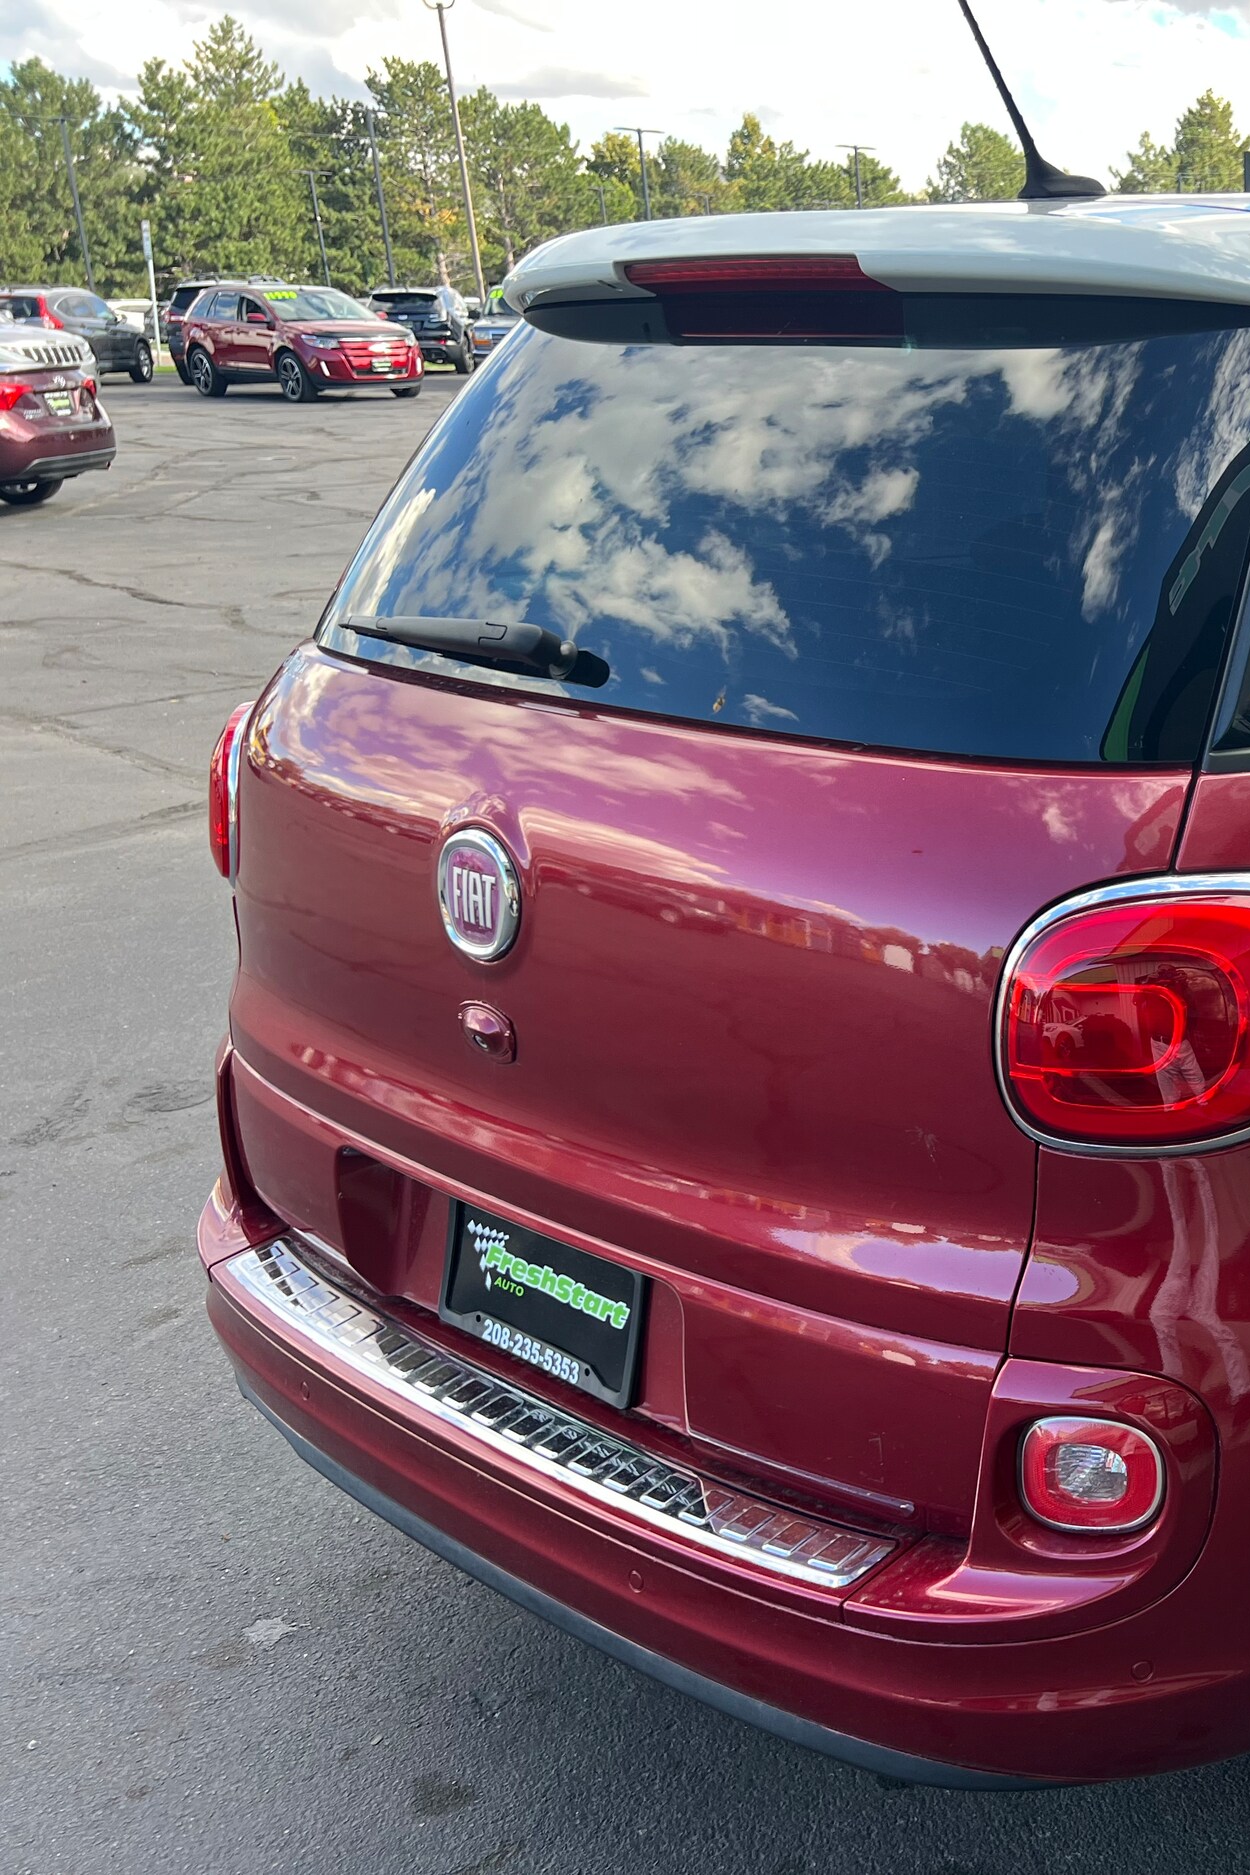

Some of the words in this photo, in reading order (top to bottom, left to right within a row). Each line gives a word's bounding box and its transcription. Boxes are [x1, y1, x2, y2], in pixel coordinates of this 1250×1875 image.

[452, 866, 497, 930] FIAT
[485, 1244, 631, 1330] FreshStart
[494, 1277, 525, 1298] AUTO
[481, 1318, 581, 1385] 208-235-5353
